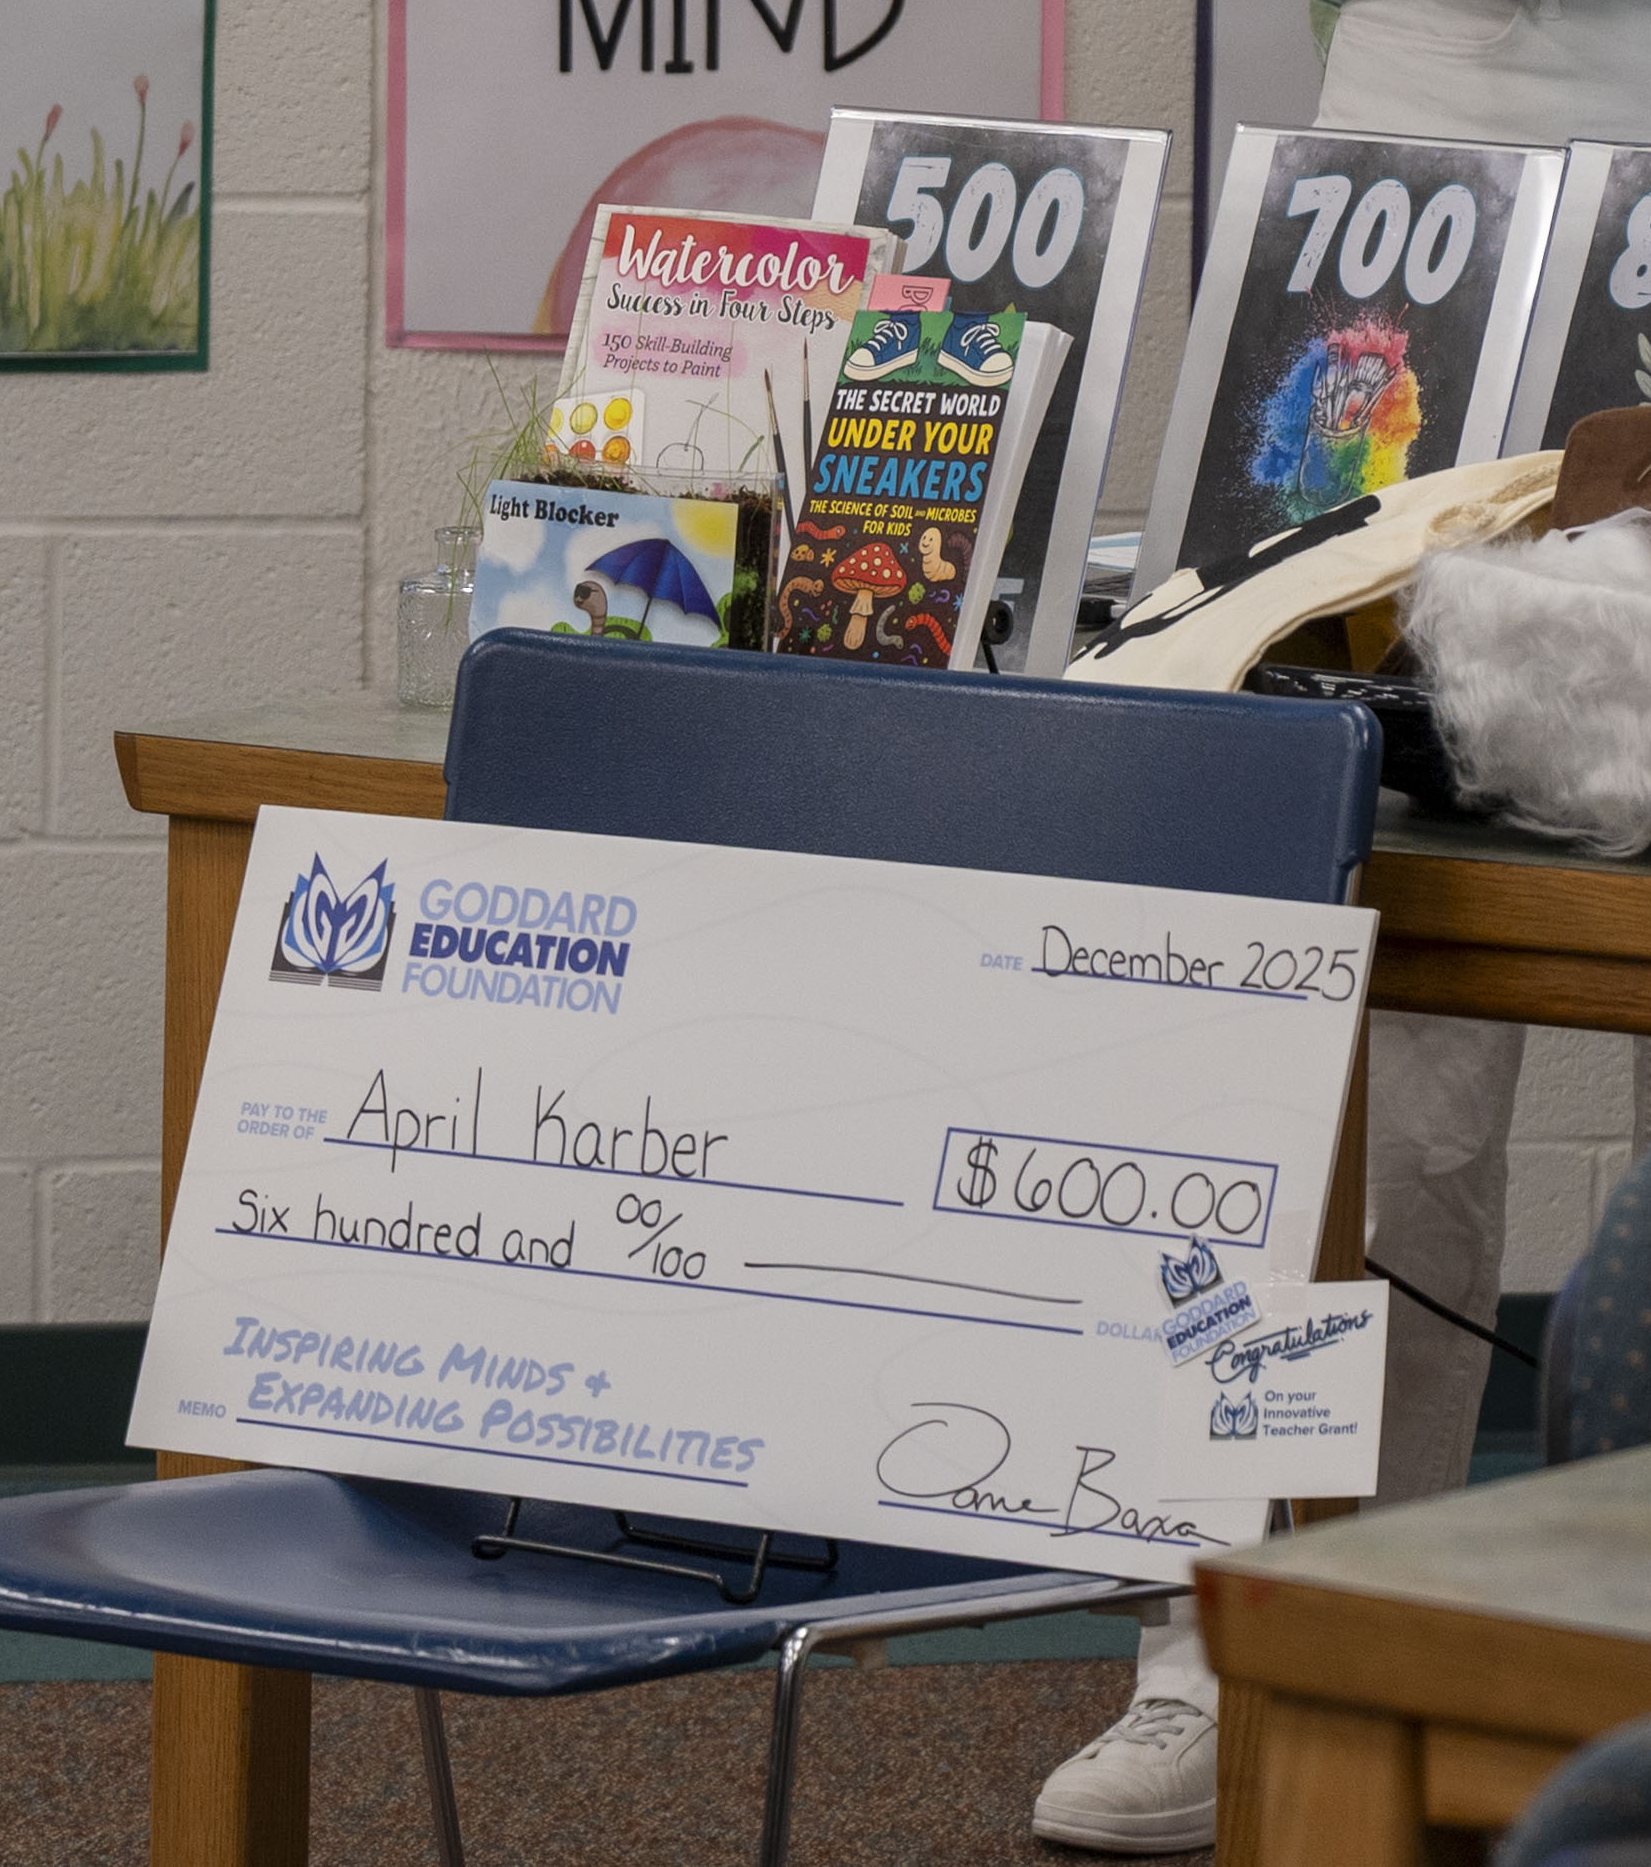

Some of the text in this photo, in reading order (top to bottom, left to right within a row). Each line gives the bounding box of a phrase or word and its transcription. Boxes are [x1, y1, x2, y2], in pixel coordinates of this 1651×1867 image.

[886, 156, 1084, 288] 500
[1286, 173, 1477, 305] 700
[618, 224, 855, 294] Watercolor
[607, 283, 836, 333] Success in Four Steps
[602, 334, 733, 362] 150 Skill-Building
[603, 355, 721, 378] Projects to Paint
[836, 389, 1002, 416] THE SECRET WORLD
[827, 418, 995, 455] UNDER YOUR
[813, 453, 988, 502] SNEAKERS
[490, 494, 619, 528] Light Blocker
[809, 500, 828, 514] THE
[829, 502, 873, 517] SCIENCE
[874, 504, 889, 518] OF
[890, 505, 914, 519] SOIL
[925, 507, 977, 523] MICROBES
[863, 520, 912, 537] FOR KIDS
[419, 878, 637, 937] GODDARD
[409, 923, 631, 978] EDUCATION
[980, 953, 1023, 972] DATE
[1042, 925, 1359, 1002] December 2025
[402, 962, 623, 1015] FOUNDATION
[237, 1119, 314, 1141] ORDER OF
[240, 1102, 327, 1125] PAY TO THE
[347, 1067, 729, 1179] April Karber
[231, 1188, 290, 1234] Six
[313, 1194, 481, 1258] hundred
[501, 1219, 576, 1269] and
[1162, 1280, 1247, 1333] GODDARD
[1167, 1294, 1252, 1350] EDUCATION
[223, 1315, 425, 1379] INSPIRING
[438, 1342, 575, 1398] MINDS
[1172, 1309, 1256, 1364] FOUNDATION
[178, 1398, 227, 1420] MEMO
[248, 1371, 765, 1472] EXPANDING POSSIBILITIES
[1263, 1407, 1331, 1419] Innovative
[1265, 1391, 1317, 1404] On your
[1263, 1423, 1358, 1436] Teacher Grant!
